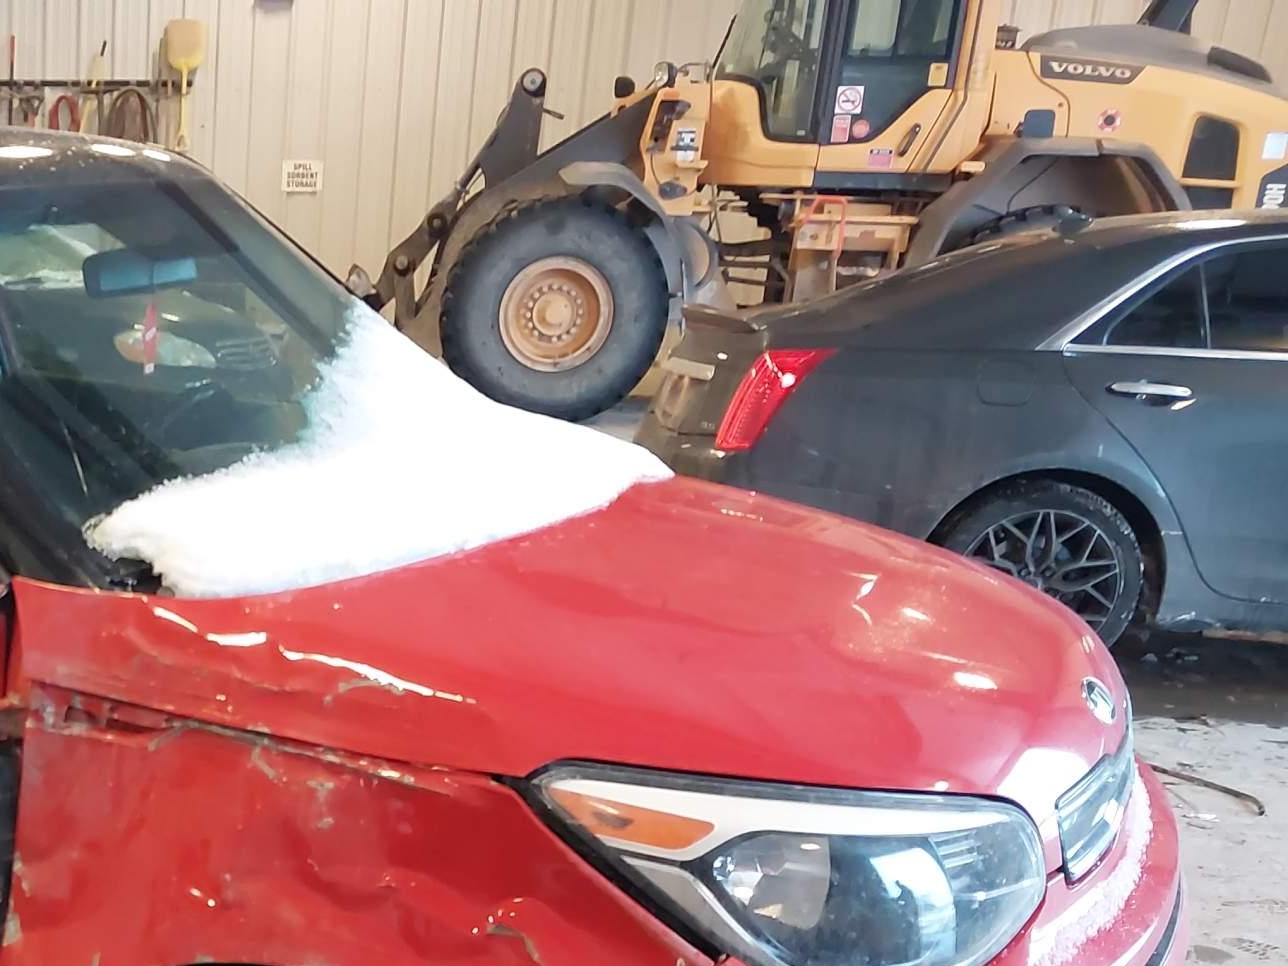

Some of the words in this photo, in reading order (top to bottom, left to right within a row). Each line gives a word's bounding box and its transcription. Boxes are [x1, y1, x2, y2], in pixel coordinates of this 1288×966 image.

[1048, 61, 1132, 78] VOLVO
[293, 163, 312, 171] SPILL
[287, 180, 317, 188] STORAGE
